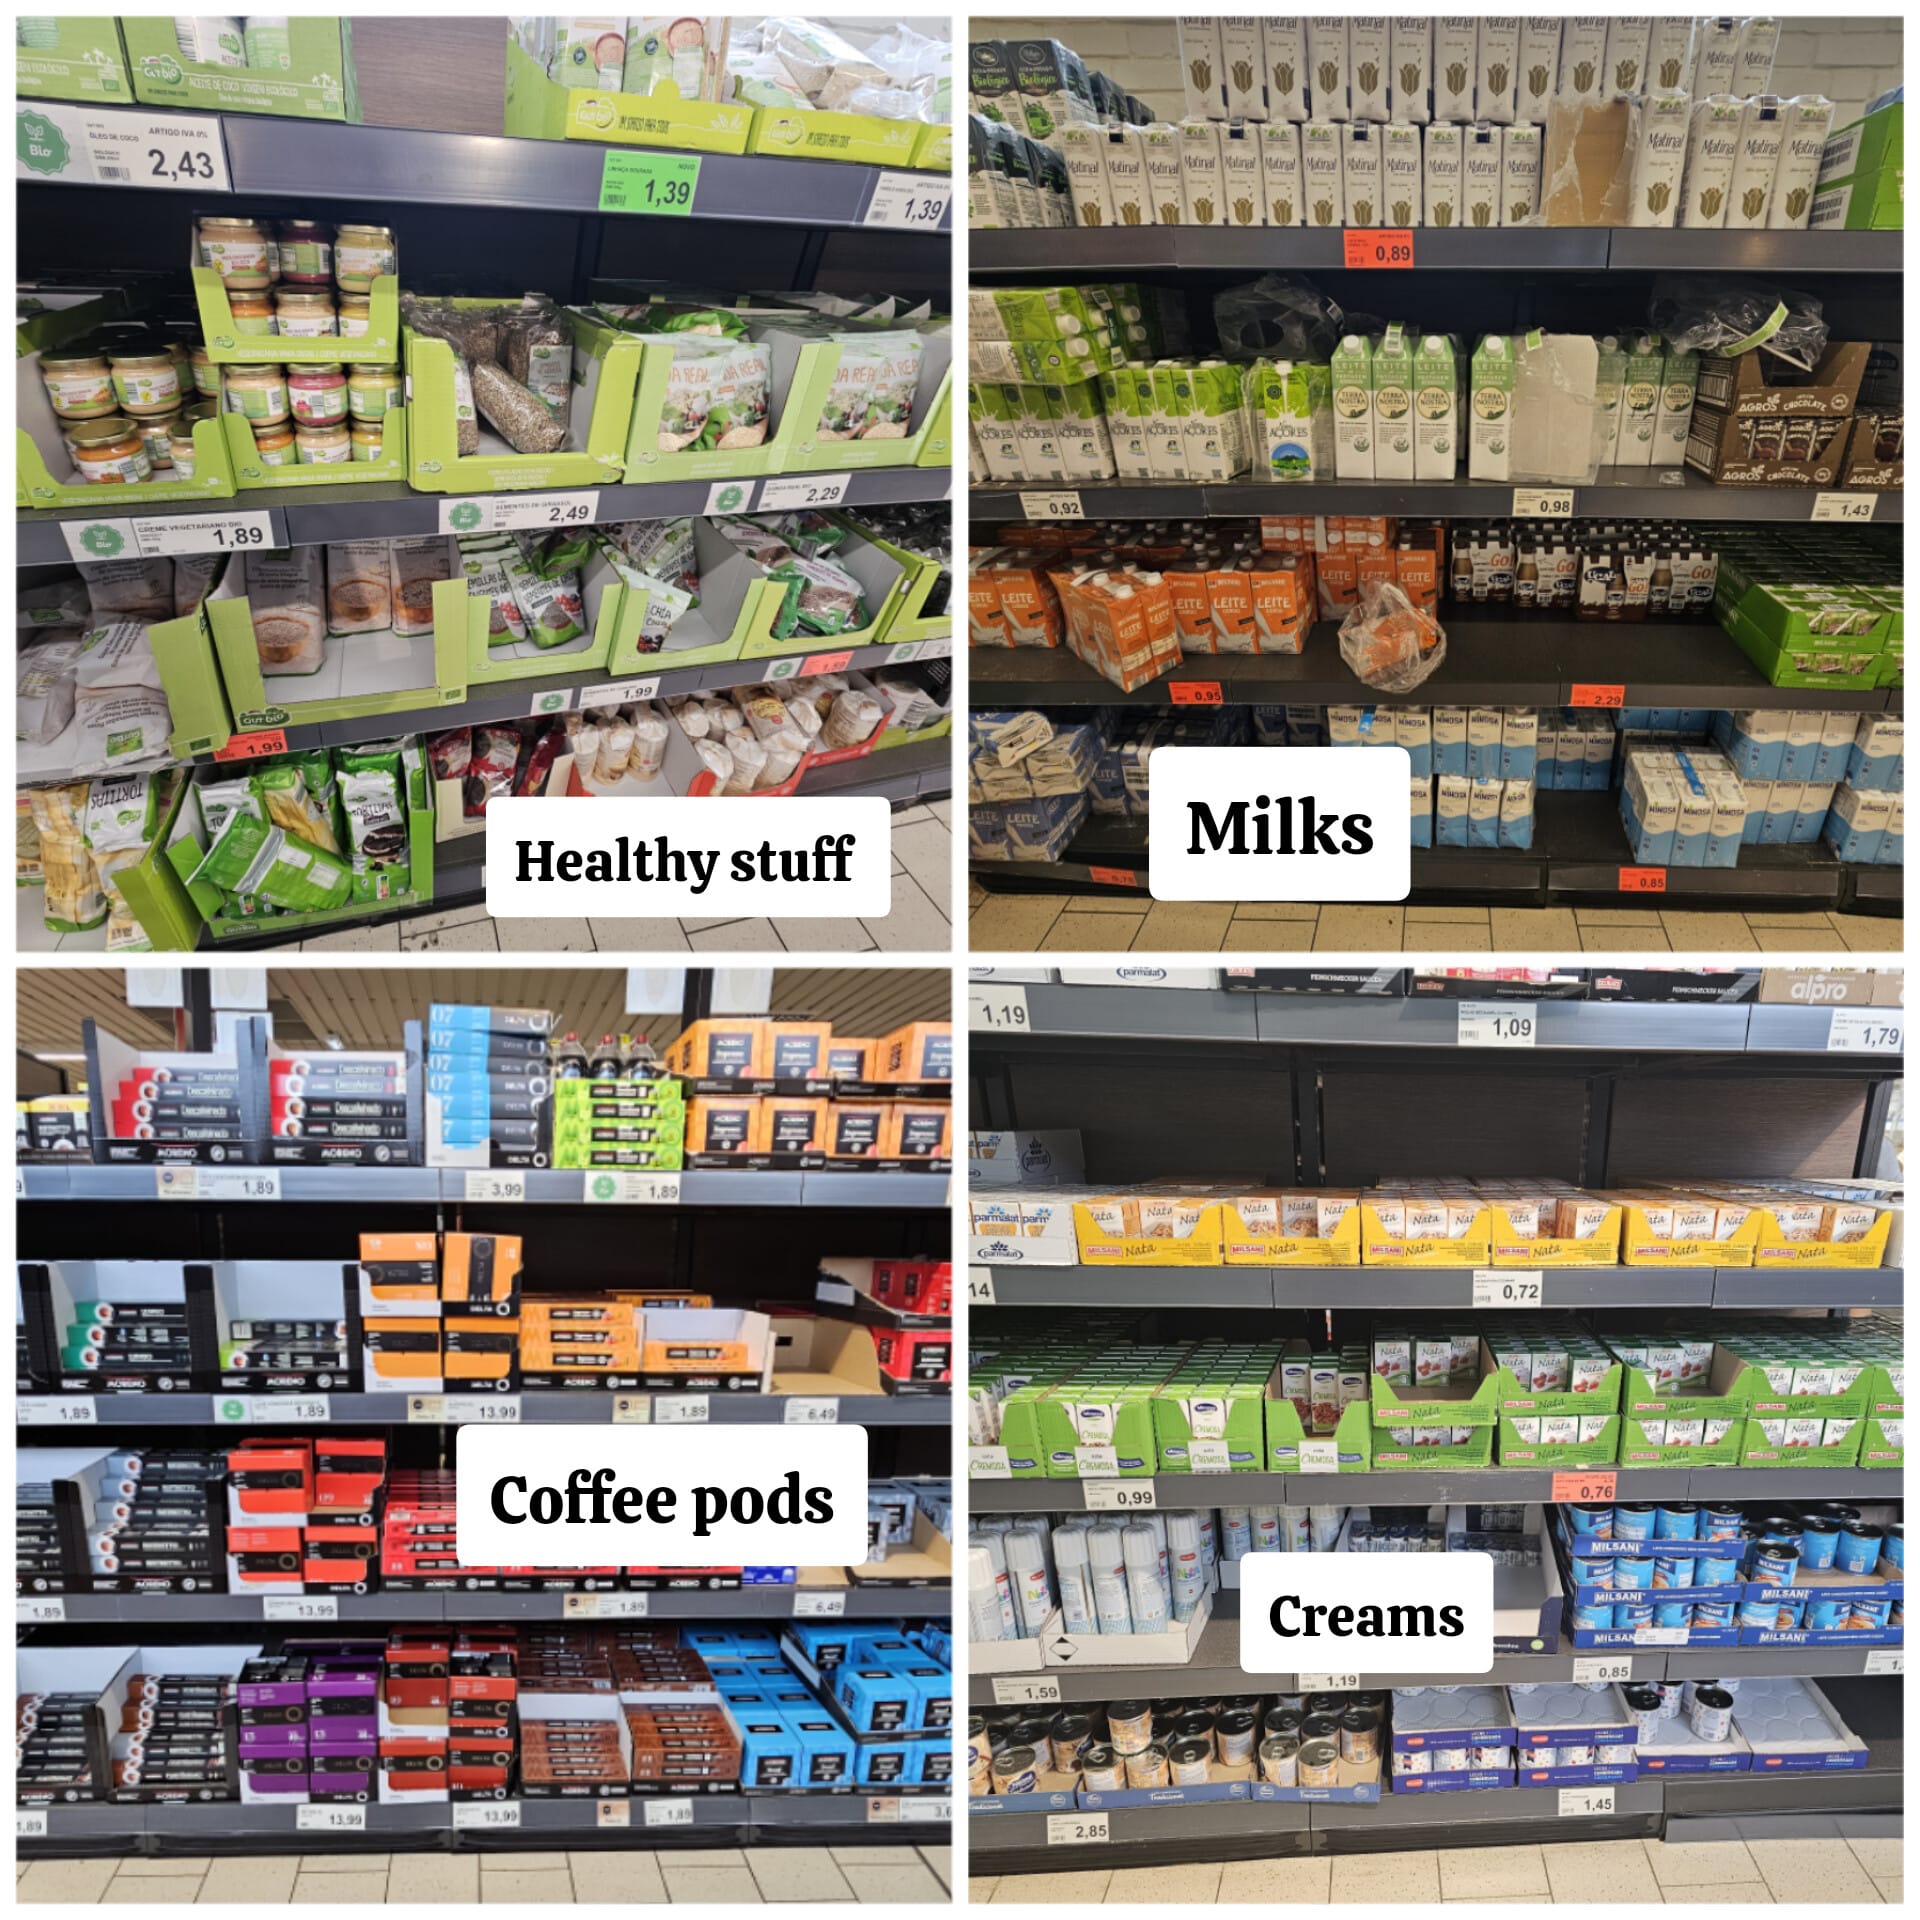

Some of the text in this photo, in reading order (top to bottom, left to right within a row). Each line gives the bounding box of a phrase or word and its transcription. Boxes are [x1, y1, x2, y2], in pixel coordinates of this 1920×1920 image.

[148, 127, 181, 138] ARTIGO
[181, 129, 196, 139] IVA
[1648, 132, 1684, 150] Matinal
[1745, 138, 1781, 155] Matinal
[29, 144, 52, 157] Bio
[148, 149, 215, 181] 2,43
[1184, 154, 1216, 171] Matinal
[1225, 154, 1257, 171] Matinal
[1264, 155, 1297, 172] Matinal
[1306, 156, 1337, 172] Matinal
[1346, 157, 1378, 173] Matinal
[1386, 157, 1418, 173] Matinal
[645, 179, 690, 208] 1,39
[904, 197, 942, 221] 1,39
[1375, 245, 1411, 262] 0,89
[738, 359, 768, 378] REAL
[1336, 362, 1368, 371] LEITE
[1375, 362, 1408, 371] LEITE
[1341, 391, 1364, 399] TERRA
[1381, 391, 1405, 399] TERRA
[1422, 391, 1445, 399] TERRA
[1479, 391, 1502, 399] TERRA
[1339, 399, 1368, 407] NOSTRA
[1378, 399, 1408, 407] NOSTRA
[1418, 399, 1448, 407] NOSTRA
[1475, 399, 1507, 407] NOSTRA
[1738, 400, 1828, 412] AGROS CHOCOLATE
[1723, 471, 1811, 483] AGROS CHOCOLATE
[1849, 475, 1888, 485] AGROS
[806, 485, 841, 504] 2,29
[549, 505, 590, 523] 2,49
[1049, 501, 1080, 517] 0,92
[1539, 500, 1570, 514] 0,98
[1840, 503, 1871, 517] 1,43
[212, 527, 264, 547] 1,89
[1321, 570, 1352, 582] LEITE
[1401, 571, 1434, 583] LEITE
[1690, 565, 1718, 580] Go!
[1002, 592, 1036, 605] LEITE
[1213, 598, 1248, 610] LEITE
[1257, 597, 1292, 609] LEITE
[1119, 622, 1143, 637] LEITE
[621, 686, 653, 699] 1,99
[1648, 806, 1677, 817] MIMOSA
[1684, 808, 1712, 818] MIMOSA
[1717, 807, 1745, 818] MIMOSA
[1122, 968, 1163, 980] parmalat
[1790, 978, 1848, 1005] alpro
[430, 1010, 455, 1025] 07
[981, 1003, 1026, 1026] 1,19
[1491, 1017, 1532, 1038] 1,09
[430, 1031, 455, 1047] 07
[1862, 1027, 1900, 1047] 1,79
[429, 1075, 453, 1092] 07
[243, 1179, 275, 1195] 1,89
[491, 1182, 522, 1198] 3,99
[649, 1184, 679, 1199] 1,89
[1243, 1202, 1269, 1215] Nata
[974, 1213, 1020, 1224] parmalat
[1681, 1215, 1707, 1227] Nata
[1086, 1243, 1157, 1257] MILSANI Nata
[1230, 1241, 1298, 1257] MILSANI Nata
[1371, 1241, 1436, 1257] MILSANI Nata
[1496, 1243, 1563, 1259] MILSANI Nata
[1635, 1243, 1701, 1258] MILSANI Nata
[1762, 1244, 1827, 1260] MILSANI Nata
[1502, 1284, 1540, 1300] 0,72
[60, 1407, 91, 1421] 1,89
[296, 1405, 325, 1418] 1,89
[478, 1406, 517, 1420] 13,99
[679, 1405, 708, 1418] 1,89
[807, 1407, 837, 1420] 6,49
[1546, 1421, 1573, 1434] Nata
[1671, 1423, 1697, 1436] Nata
[1116, 1492, 1153, 1506] 0,99
[1580, 1484, 1614, 1500] 0,76
[1591, 1541, 1641, 1554] MILSANI
[1594, 1590, 1644, 1603] MILSANI
[1761, 1588, 1812, 1600] MILSANI
[298, 1606, 335, 1618] 13,99
[620, 1602, 646, 1613] 1,89
[815, 1602, 843, 1613] 6,49
[1759, 1631, 1808, 1644] MILSANI
[1599, 1666, 1630, 1679] 0,85
[1325, 1674, 1358, 1688] 1,19
[1024, 1686, 1059, 1701] 1,59
[1584, 1797, 1613, 1811] 1,45
[329, 1813, 363, 1826] 13,99
[484, 1809, 519, 1824] 13,99
[667, 1808, 693, 1822] 1,89
[1075, 1824, 1107, 1839] 2,85
